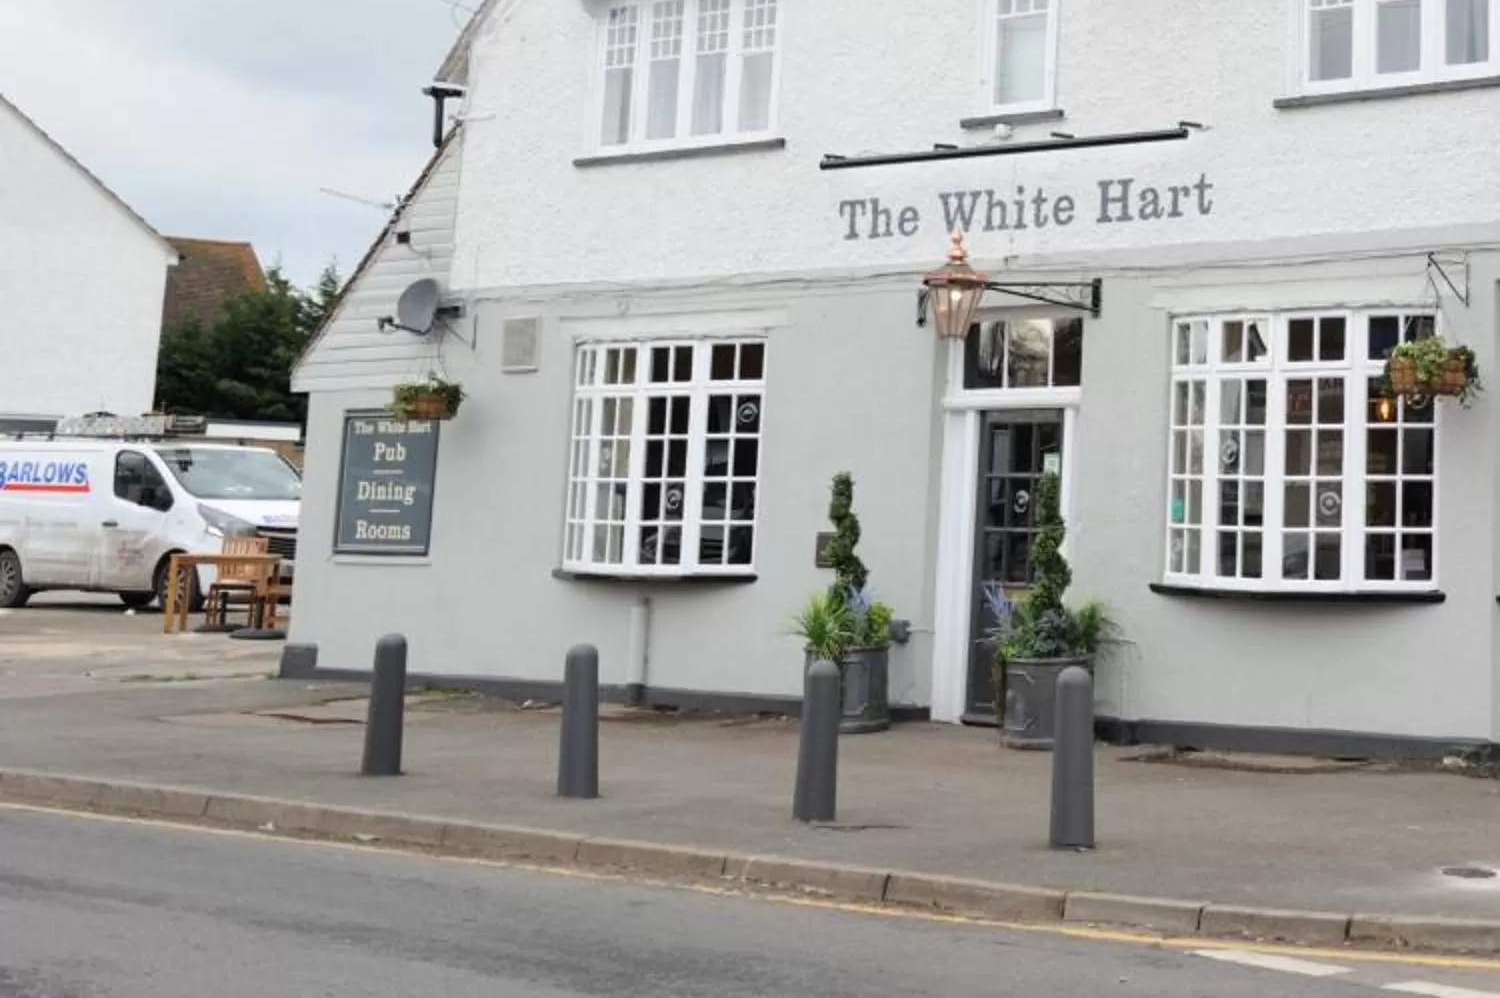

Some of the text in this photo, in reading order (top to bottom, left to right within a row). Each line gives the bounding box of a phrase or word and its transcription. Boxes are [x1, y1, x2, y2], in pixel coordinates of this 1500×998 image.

[839, 173, 1214, 240] The White Hart
[373, 442, 406, 462] Pub
[357, 481, 417, 506] Dining
[355, 519, 411, 540] Rooms
